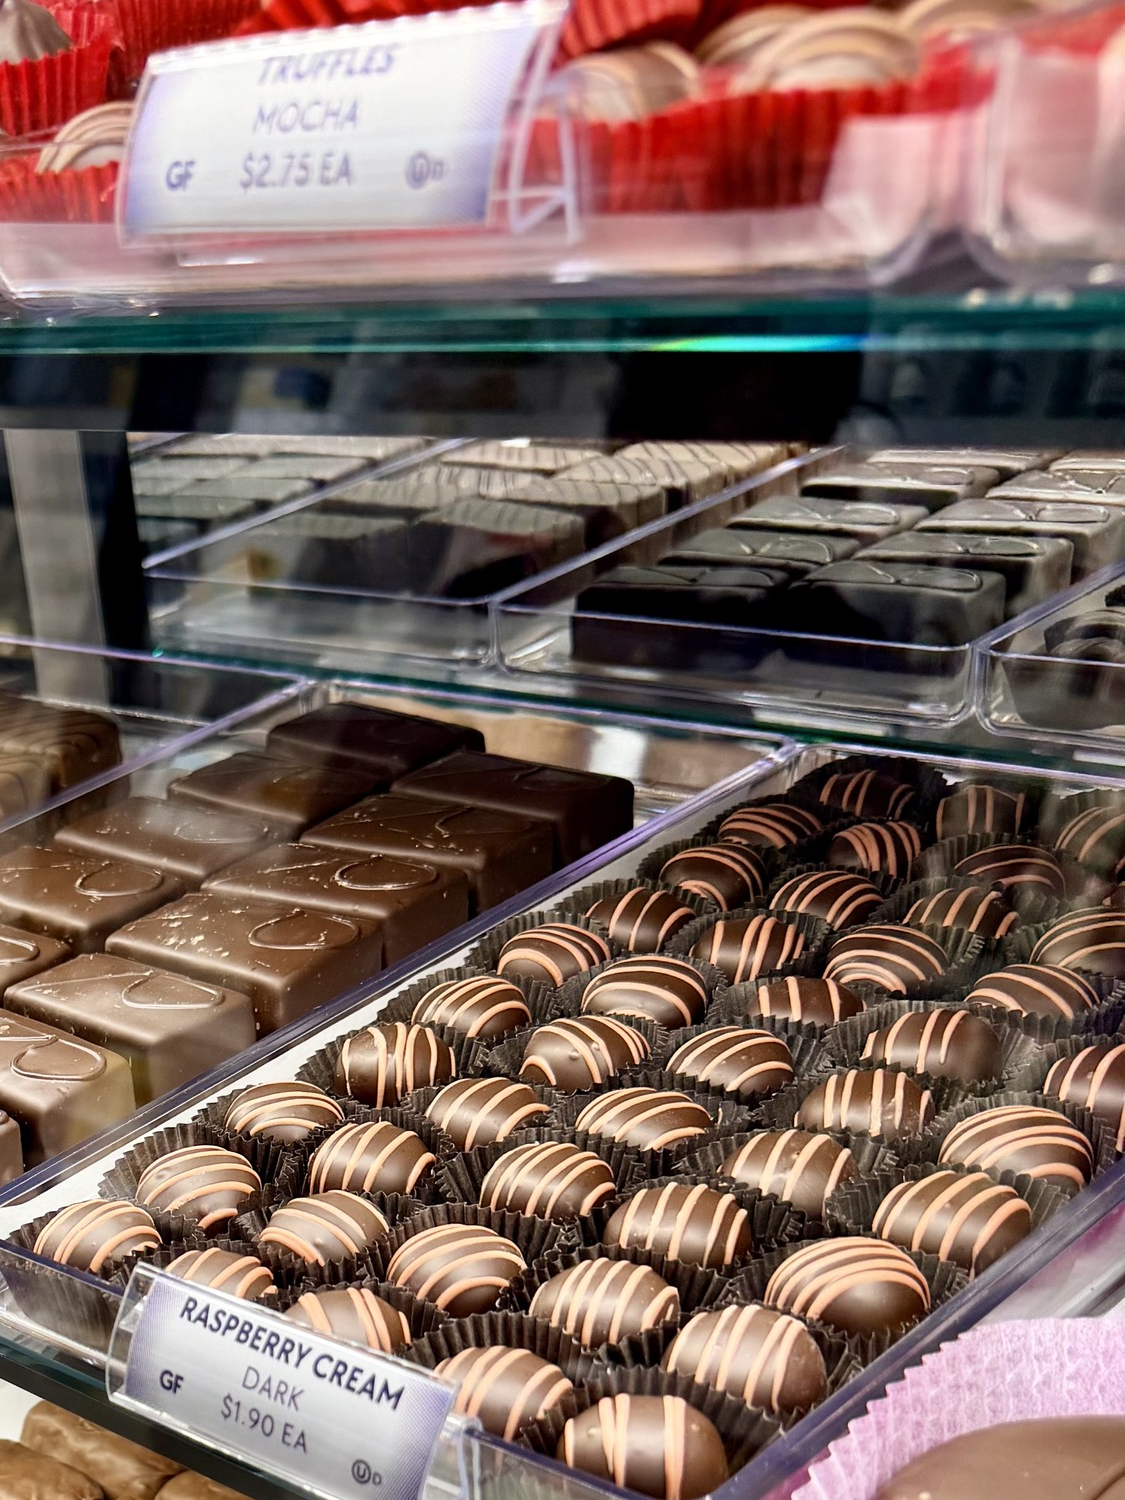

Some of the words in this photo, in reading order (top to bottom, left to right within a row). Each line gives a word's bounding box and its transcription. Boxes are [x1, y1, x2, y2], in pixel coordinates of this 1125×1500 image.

[257, 41, 399, 85] TRUFFLES
[252, 100, 359, 136] MOCHA
[165, 159, 196, 191] GF
[240, 152, 313, 195] $2.75
[320, 153, 352, 187] EA
[180, 1296, 313, 1369] RASPBERRY
[312, 1353, 406, 1412] CREAM
[159, 1369, 184, 1396] GF
[242, 1366, 306, 1413] DARK
[221, 1393, 275, 1439] $1.90
[282, 1423, 308, 1455] EA
